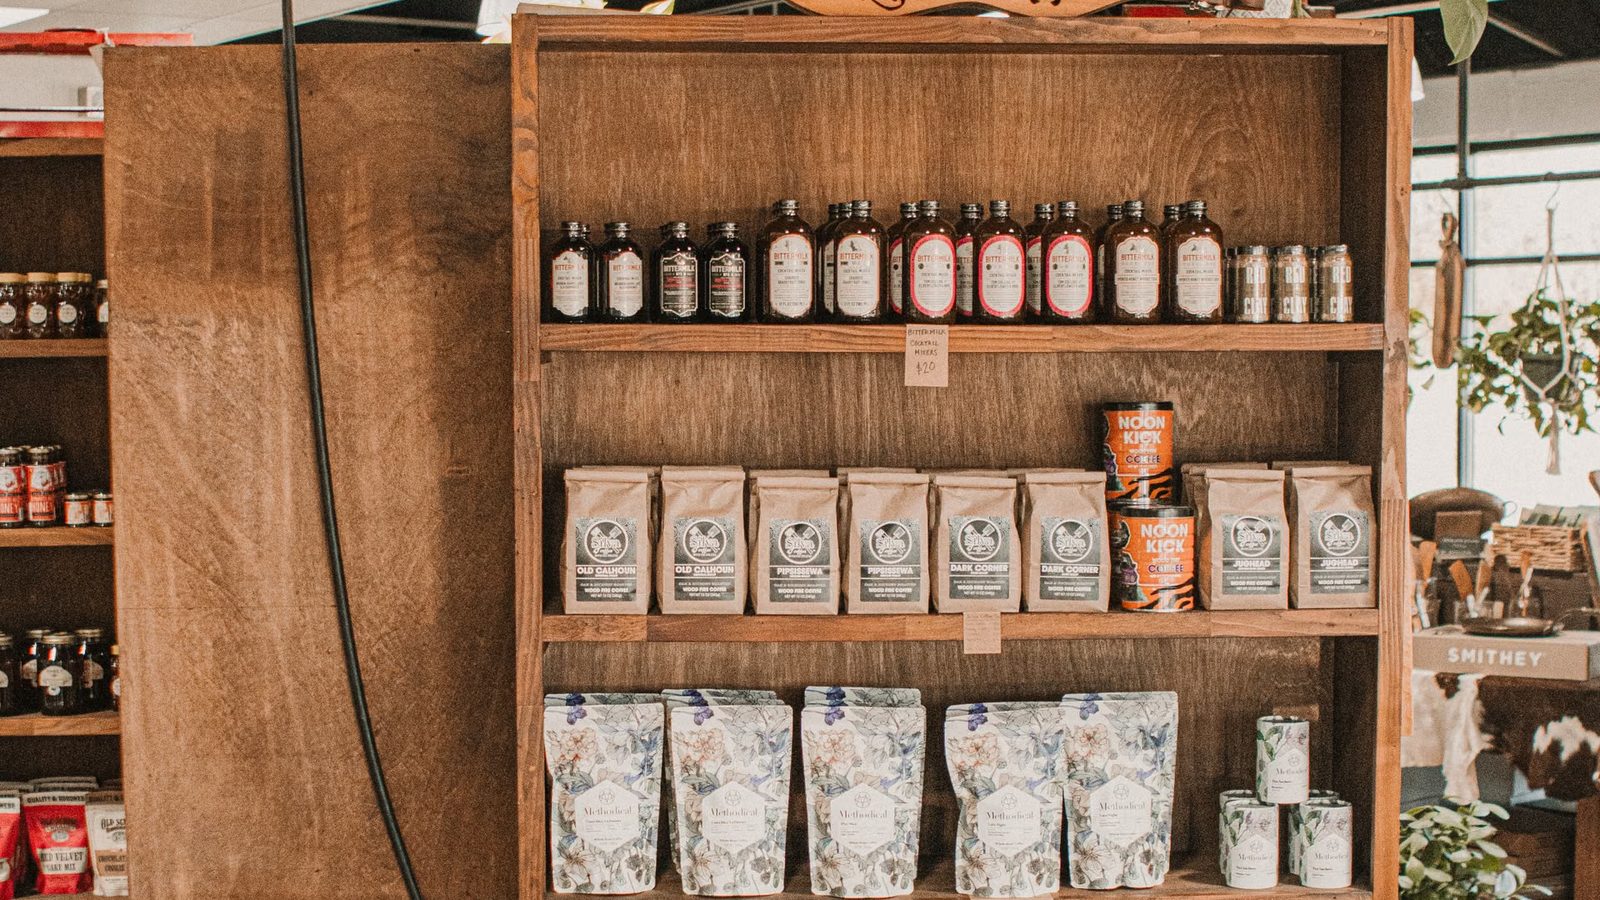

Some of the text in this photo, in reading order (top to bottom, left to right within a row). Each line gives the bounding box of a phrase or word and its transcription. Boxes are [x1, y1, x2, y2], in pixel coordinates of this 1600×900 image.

[1285, 267, 1305, 283] RED
[1332, 266, 1351, 283] RED
[916, 362, 936, 375] $20
[1118, 416, 1165, 429] NOON
[1124, 431, 1162, 444] KICK
[1140, 524, 1188, 538] NOON
[1146, 539, 1184, 553] KICK
[1148, 564, 1184, 573] COEE
[1448, 648, 1542, 667] SMITHEY
[584, 806, 632, 816] Methodical
[711, 808, 758, 816] Methodical
[840, 810, 888, 818] Methodical
[56, 852, 83, 860] VELVET
[47, 863, 61, 871] CAKE
